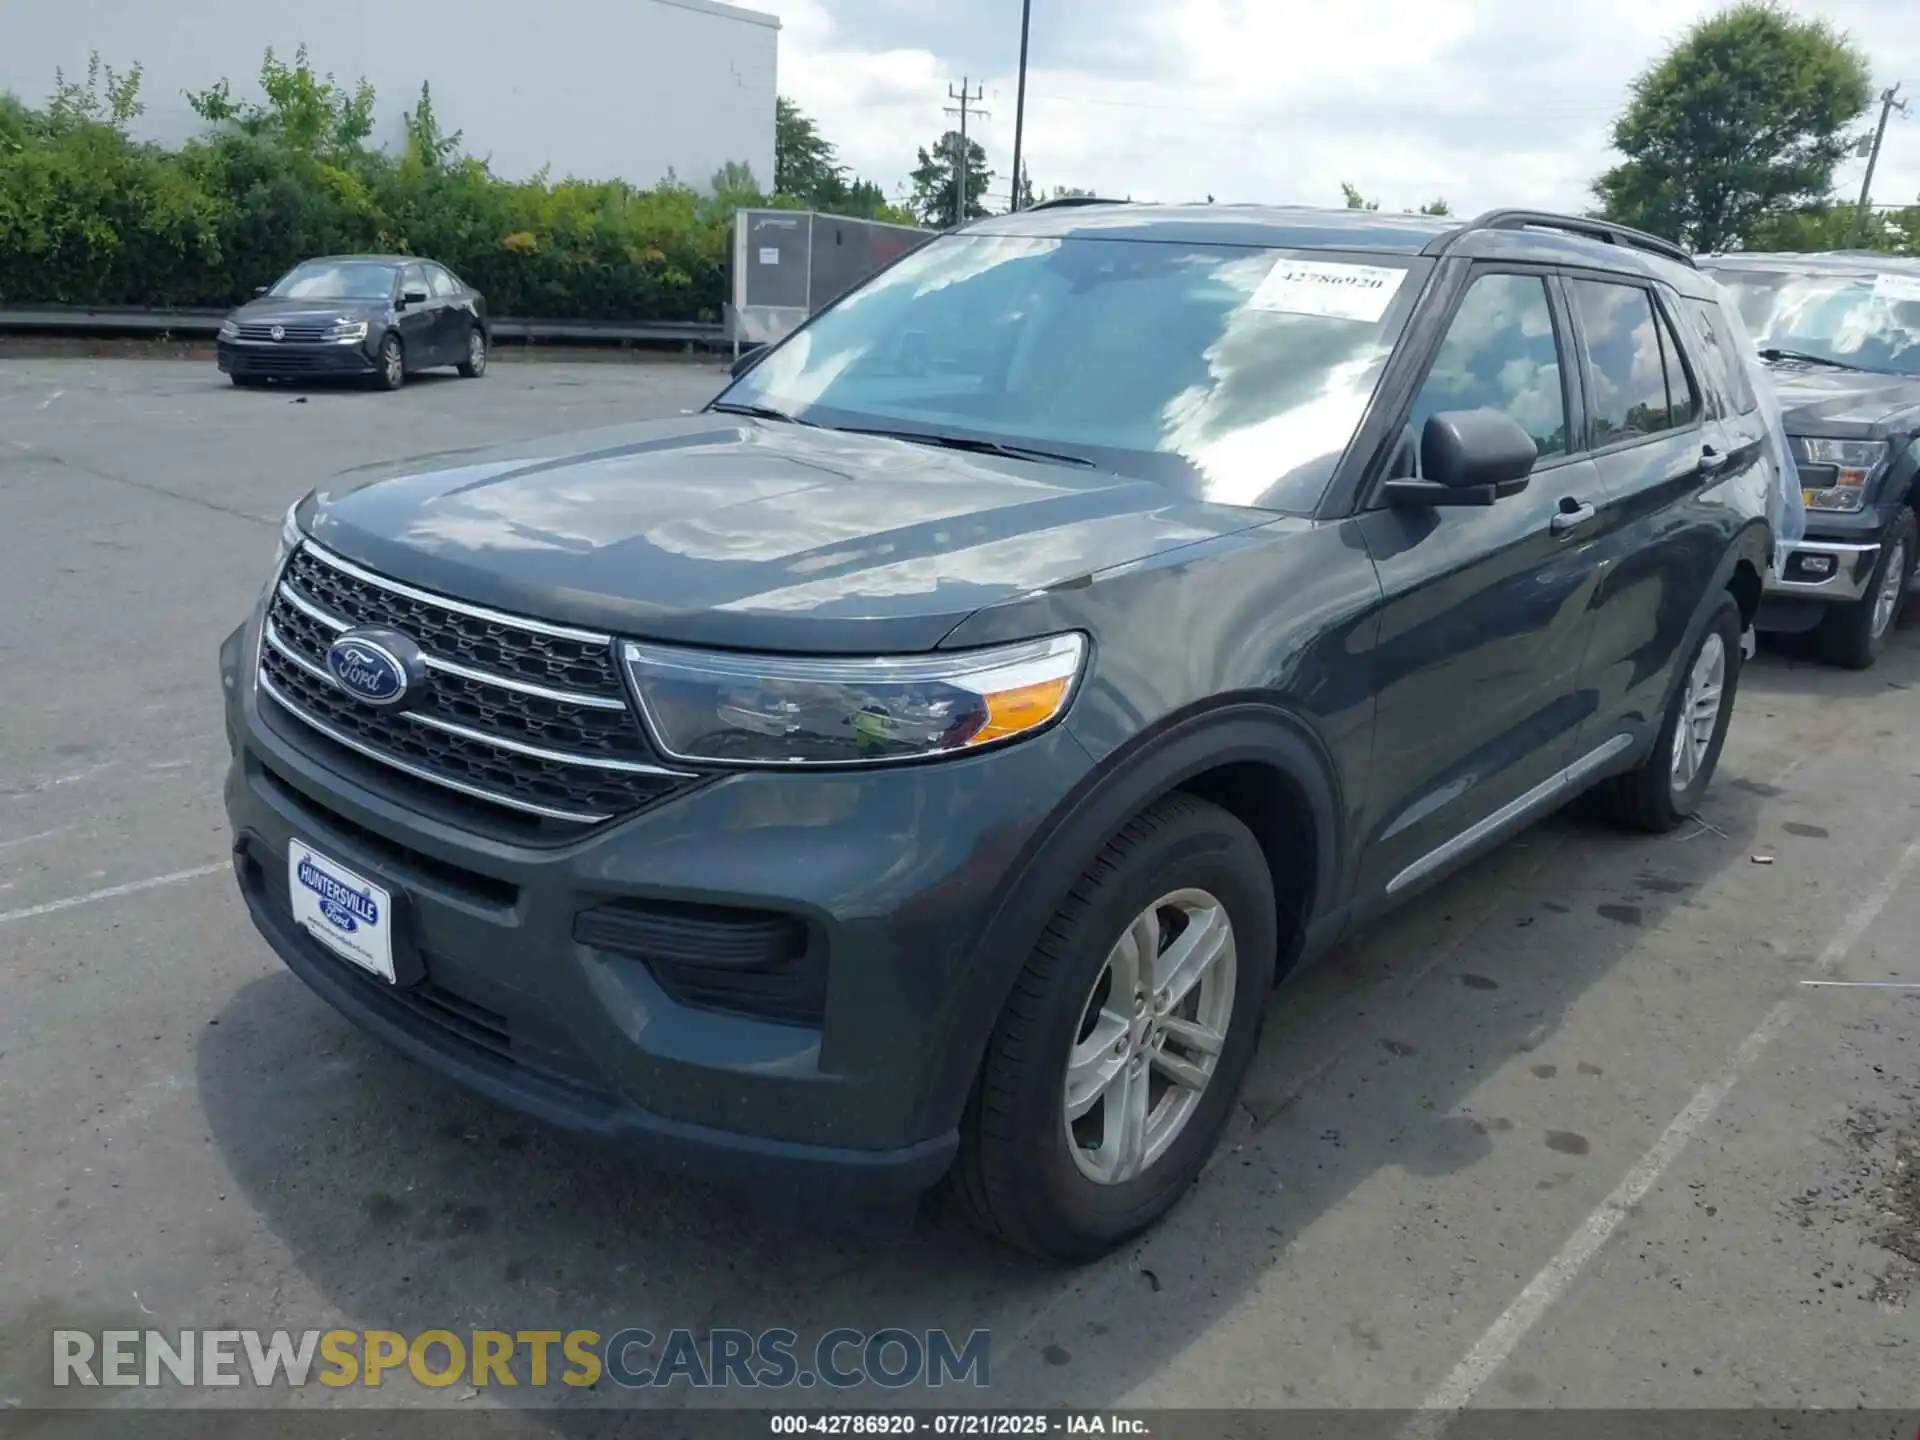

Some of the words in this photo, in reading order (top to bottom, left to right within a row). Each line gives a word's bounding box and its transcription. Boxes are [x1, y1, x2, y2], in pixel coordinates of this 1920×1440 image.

[339, 649, 384, 691] Ford
[300, 864, 375, 922] HUNTERSVILLE
[325, 901, 350, 929] Ford
